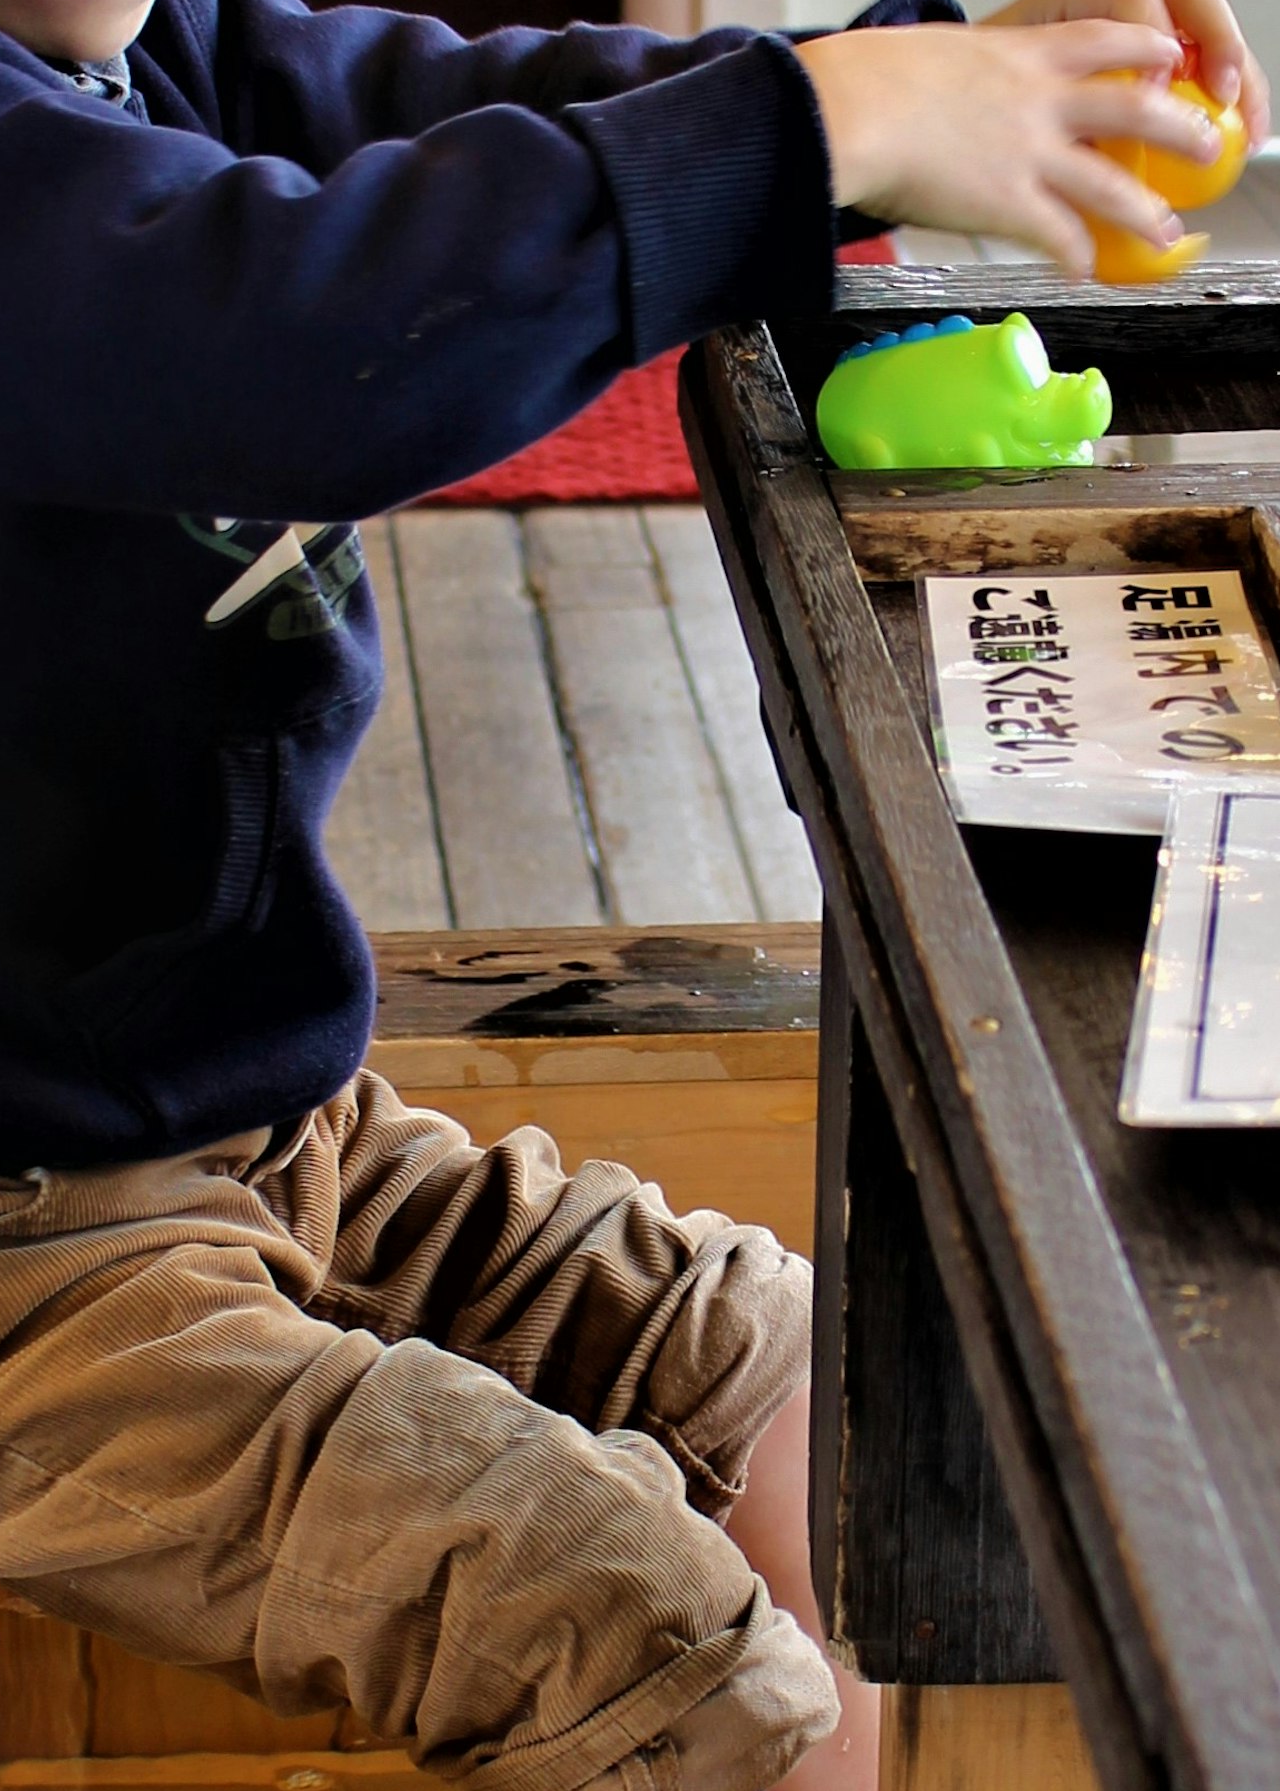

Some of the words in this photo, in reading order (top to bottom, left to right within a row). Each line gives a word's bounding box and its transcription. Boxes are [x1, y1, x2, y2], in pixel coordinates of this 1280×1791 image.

[968, 587, 1079, 776] ご遠慮ください。
[1119, 584, 1245, 762] 足湯内での
